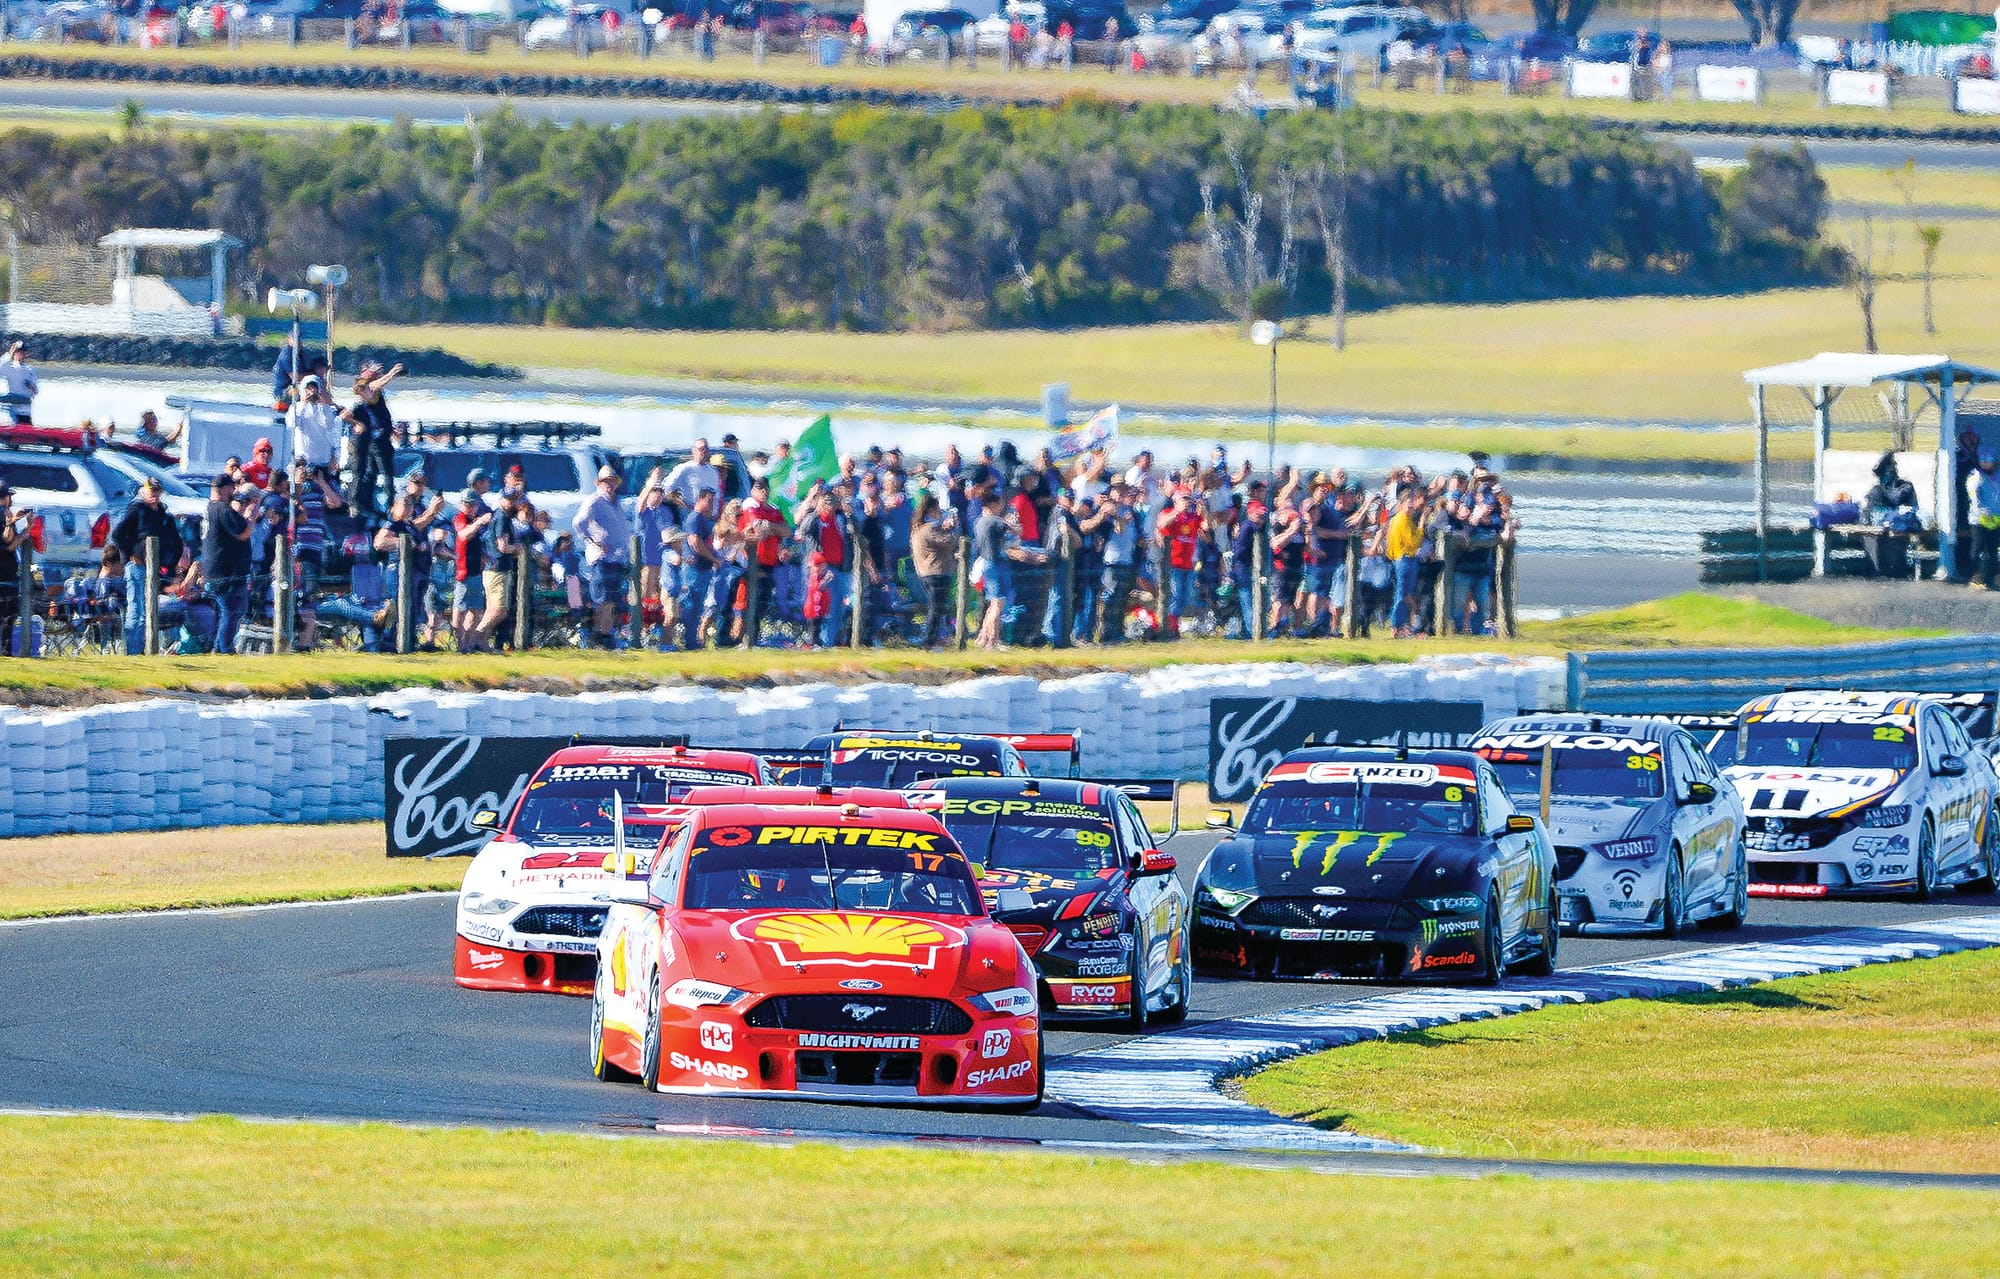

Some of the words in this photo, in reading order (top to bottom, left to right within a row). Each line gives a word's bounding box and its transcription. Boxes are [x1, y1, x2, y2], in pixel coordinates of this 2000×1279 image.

[1760, 710, 1912, 726] MEGA
[1872, 727, 1905, 743] 22
[1472, 734, 1662, 754] NULON
[550, 764, 636, 778] imar
[1626, 755, 1659, 771] 35
[1352, 766, 1424, 779] ENZED
[1444, 786, 1463, 802] 6
[755, 826, 940, 851] PIRTEK
[1075, 830, 1112, 848] 99
[1604, 840, 1642, 858] VENN
[907, 852, 944, 871] 17
[1082, 912, 1120, 934] PENRITE
[1438, 920, 1480, 934] MONSTER
[1321, 929, 1376, 941] EDGE
[1424, 951, 1476, 968] Scandia
[1072, 985, 1116, 998] RYCO
[670, 1051, 749, 1081] SHARP
[966, 1060, 1032, 1088] SHARP
